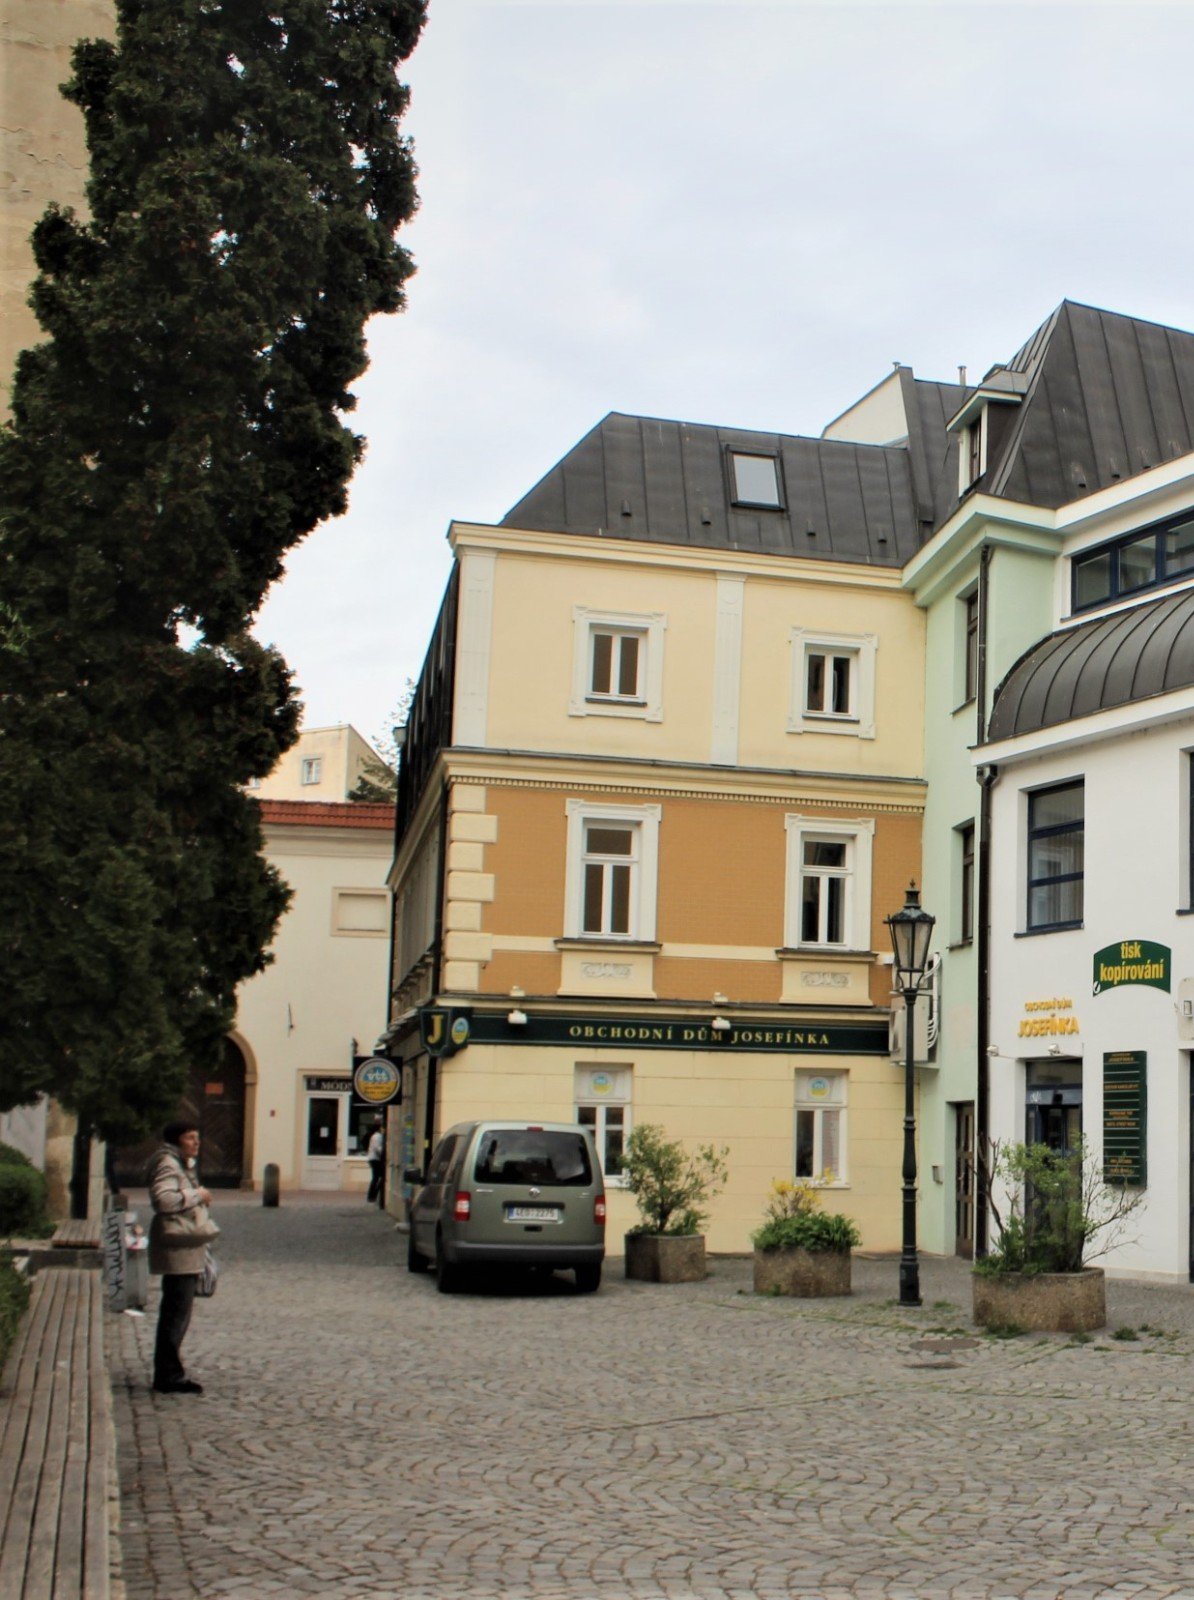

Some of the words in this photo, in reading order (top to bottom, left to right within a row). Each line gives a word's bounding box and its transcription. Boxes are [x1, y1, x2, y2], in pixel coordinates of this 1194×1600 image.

[1121, 941, 1141, 959] tisk
[1100, 959, 1165, 985] kopírování
[427, 1014, 444, 1044] J
[569, 1026, 673, 1040] OBCHODNÍ
[683, 1028, 723, 1041] DŮM
[731, 1030, 829, 1045] JOSEFÍNKA
